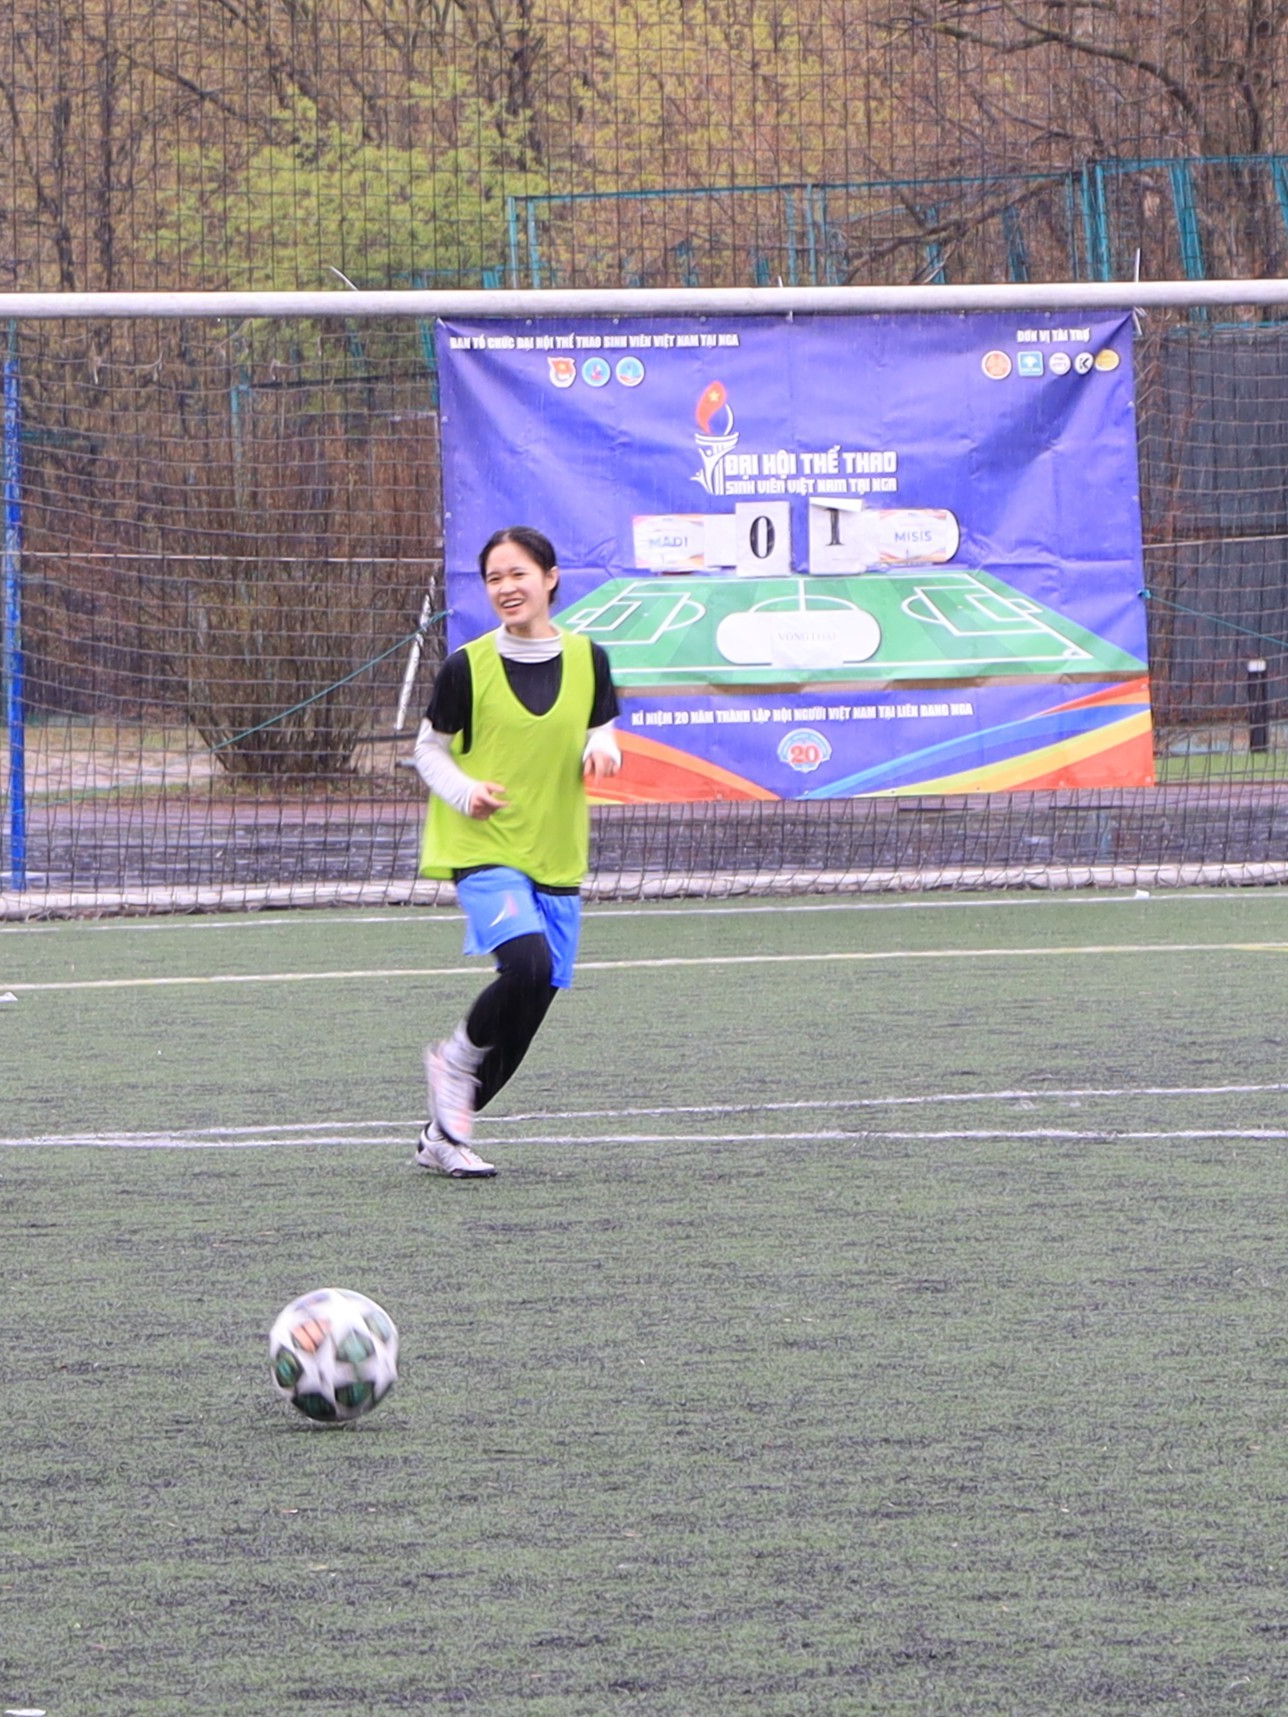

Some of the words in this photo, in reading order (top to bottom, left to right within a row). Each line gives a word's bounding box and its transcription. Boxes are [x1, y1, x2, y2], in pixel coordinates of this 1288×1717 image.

[450, 336, 470, 349] BAN
[575, 335, 602, 349] THAO
[603, 335, 627, 348] SINH
[629, 334, 651, 348] VIÊN
[653, 333, 675, 349] VIỆT
[676, 334, 699, 347] NAM
[718, 334, 739, 346] NGA
[725, 454, 758, 480] ĐẠI
[763, 450, 797, 479] HỘI
[843, 452, 897, 473] THAO
[787, 479, 815, 495] VIỆT
[817, 479, 847, 492] NAM
[849, 479, 870, 494] TẠI
[872, 478, 897, 491] NGA
[749, 515, 775, 559] 0
[895, 529, 932, 543] MISIS
[645, 711, 673, 726] NIỆM
[674, 711, 688, 724] 20
[716, 709, 750, 723] THÀNH
[752, 708, 772, 723] LẬP
[828, 706, 851, 721] VIỆT
[852, 706, 876, 719] NAM
[896, 704, 918, 718] LIÊN
[920, 704, 949, 717] BANG
[950, 703, 973, 715] NGA
[790, 745, 820, 764] 20
